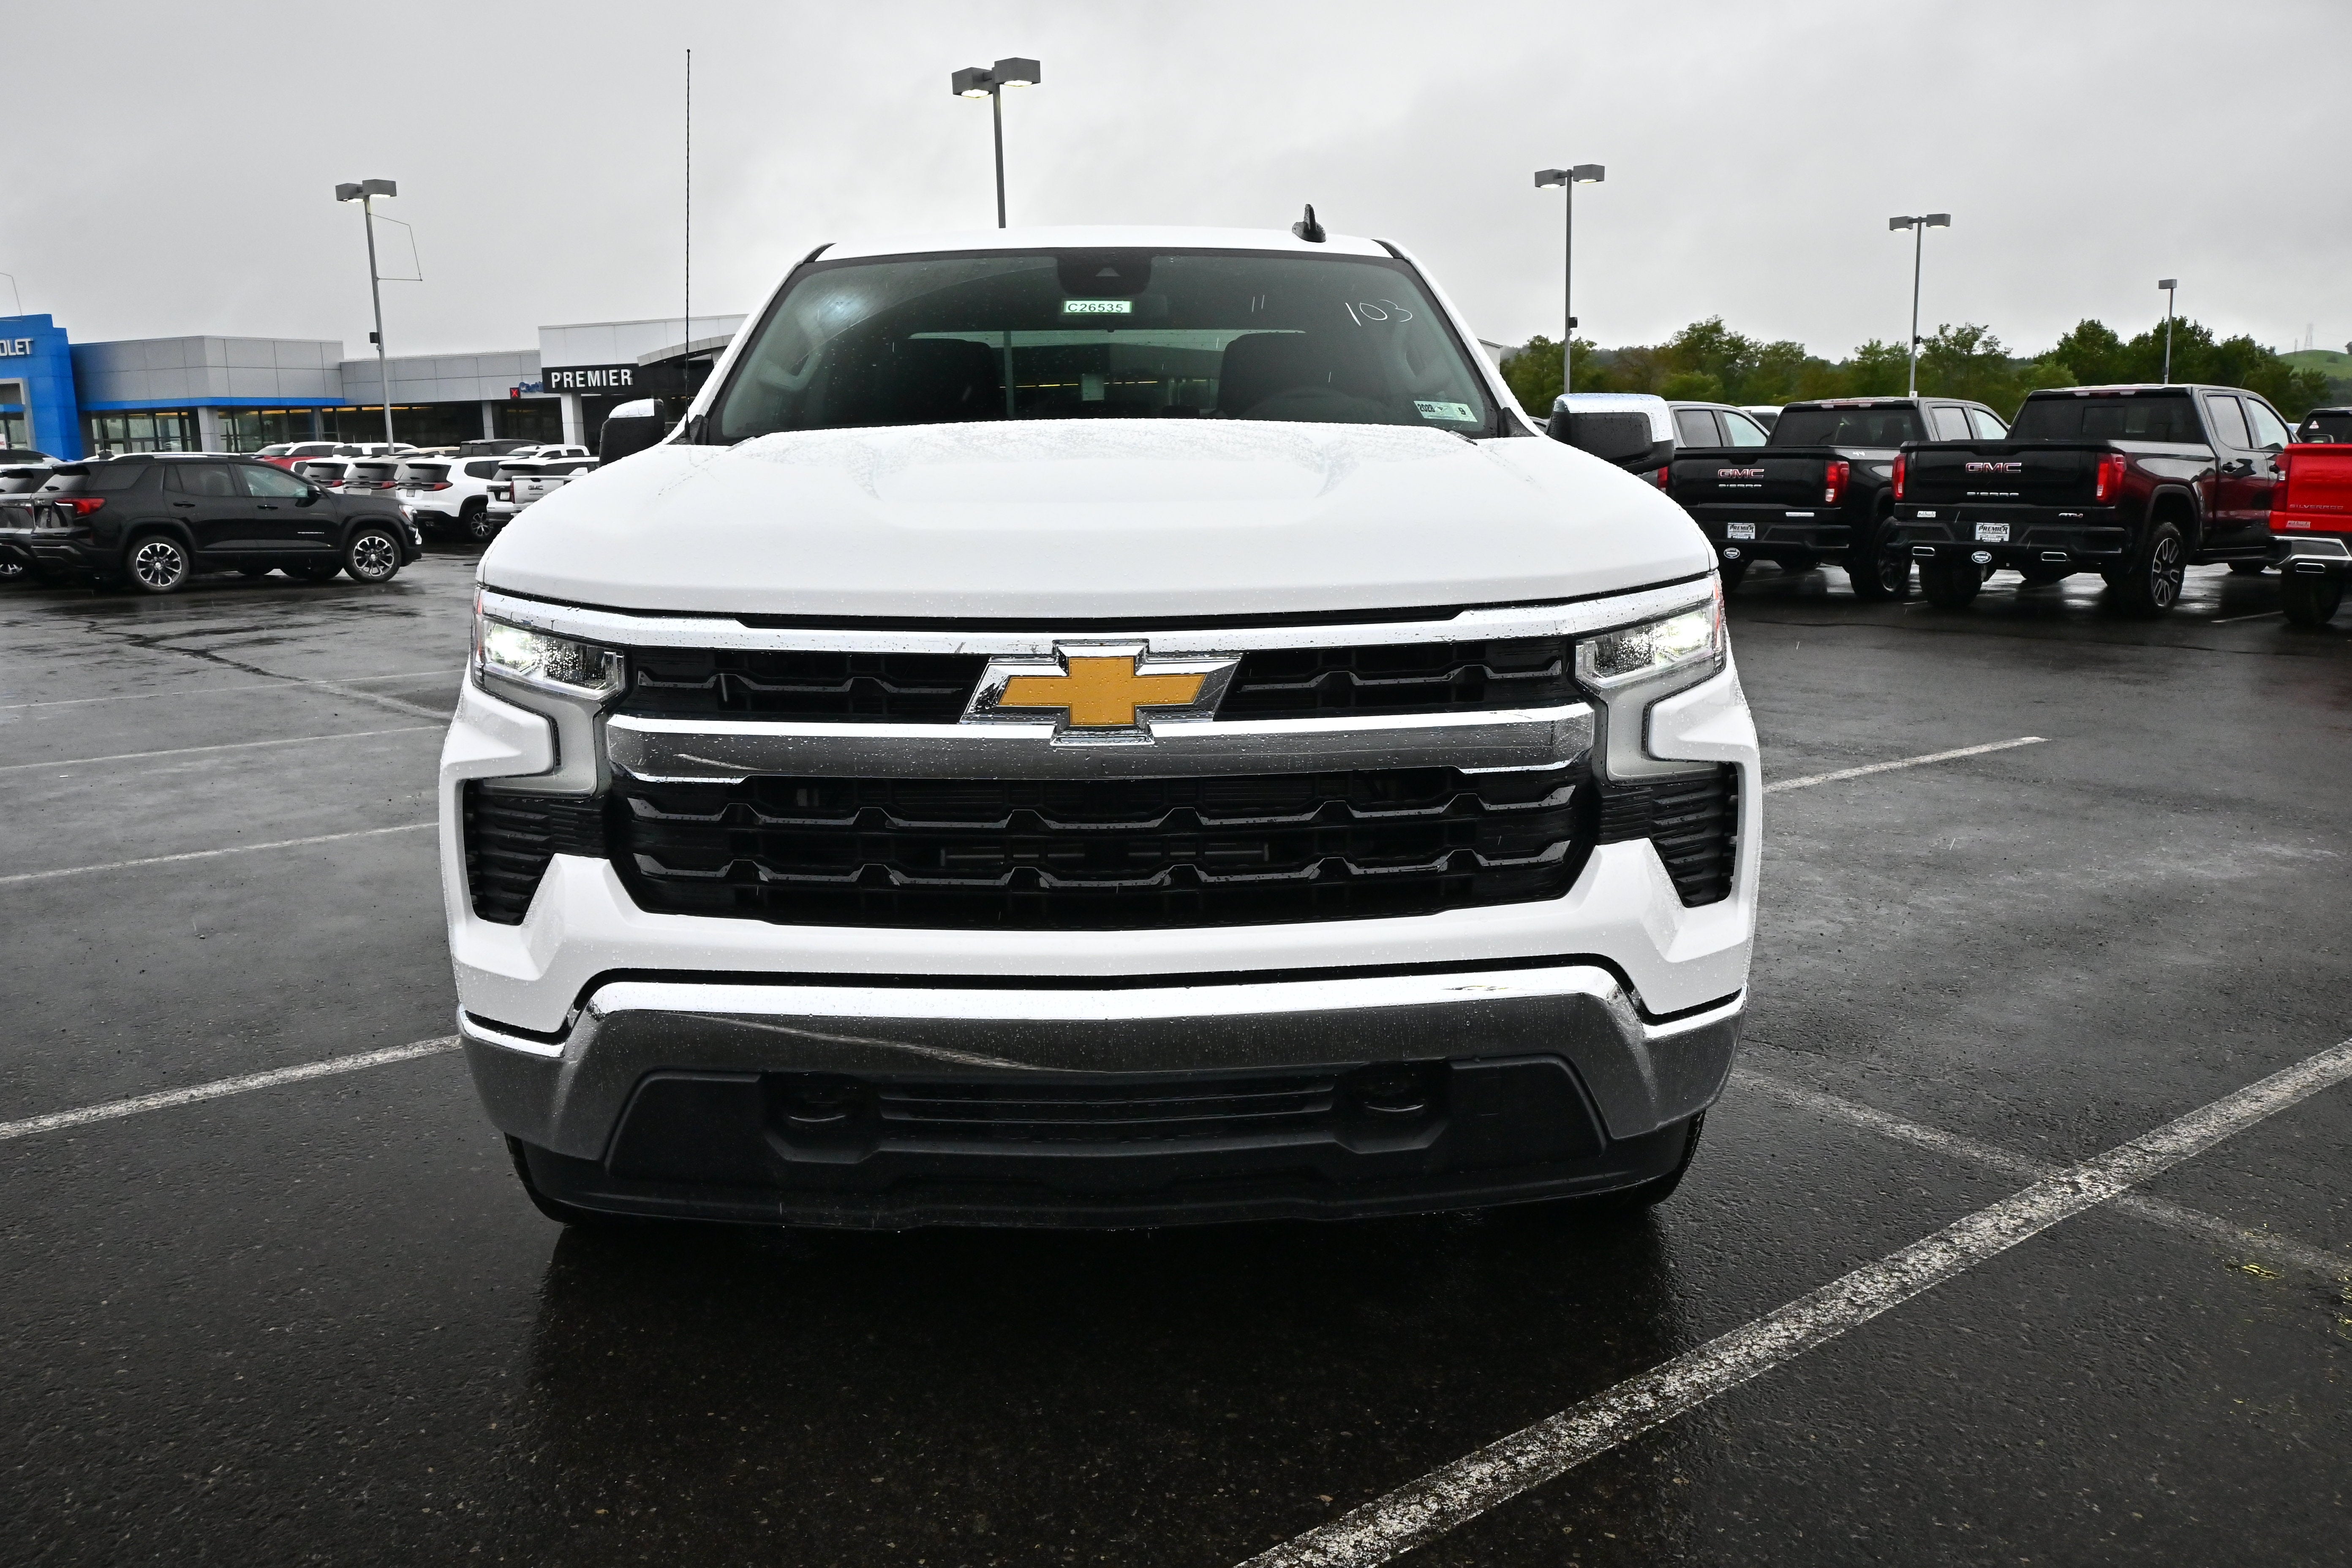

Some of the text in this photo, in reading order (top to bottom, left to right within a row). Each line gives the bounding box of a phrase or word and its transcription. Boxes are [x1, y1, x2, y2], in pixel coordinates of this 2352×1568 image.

[1068, 303, 1123, 312] C26535
[1345, 299, 1413, 327] 103
[0, 338, 33, 356] OLET
[551, 369, 633, 388] PREMIER
[1458, 407, 1466, 415] 9
[1965, 463, 2022, 473] GMC
[1718, 469, 1764, 478] GMC
[1730, 524, 1754, 533] PREMIER
[1979, 525, 2008, 534] PREMIER
